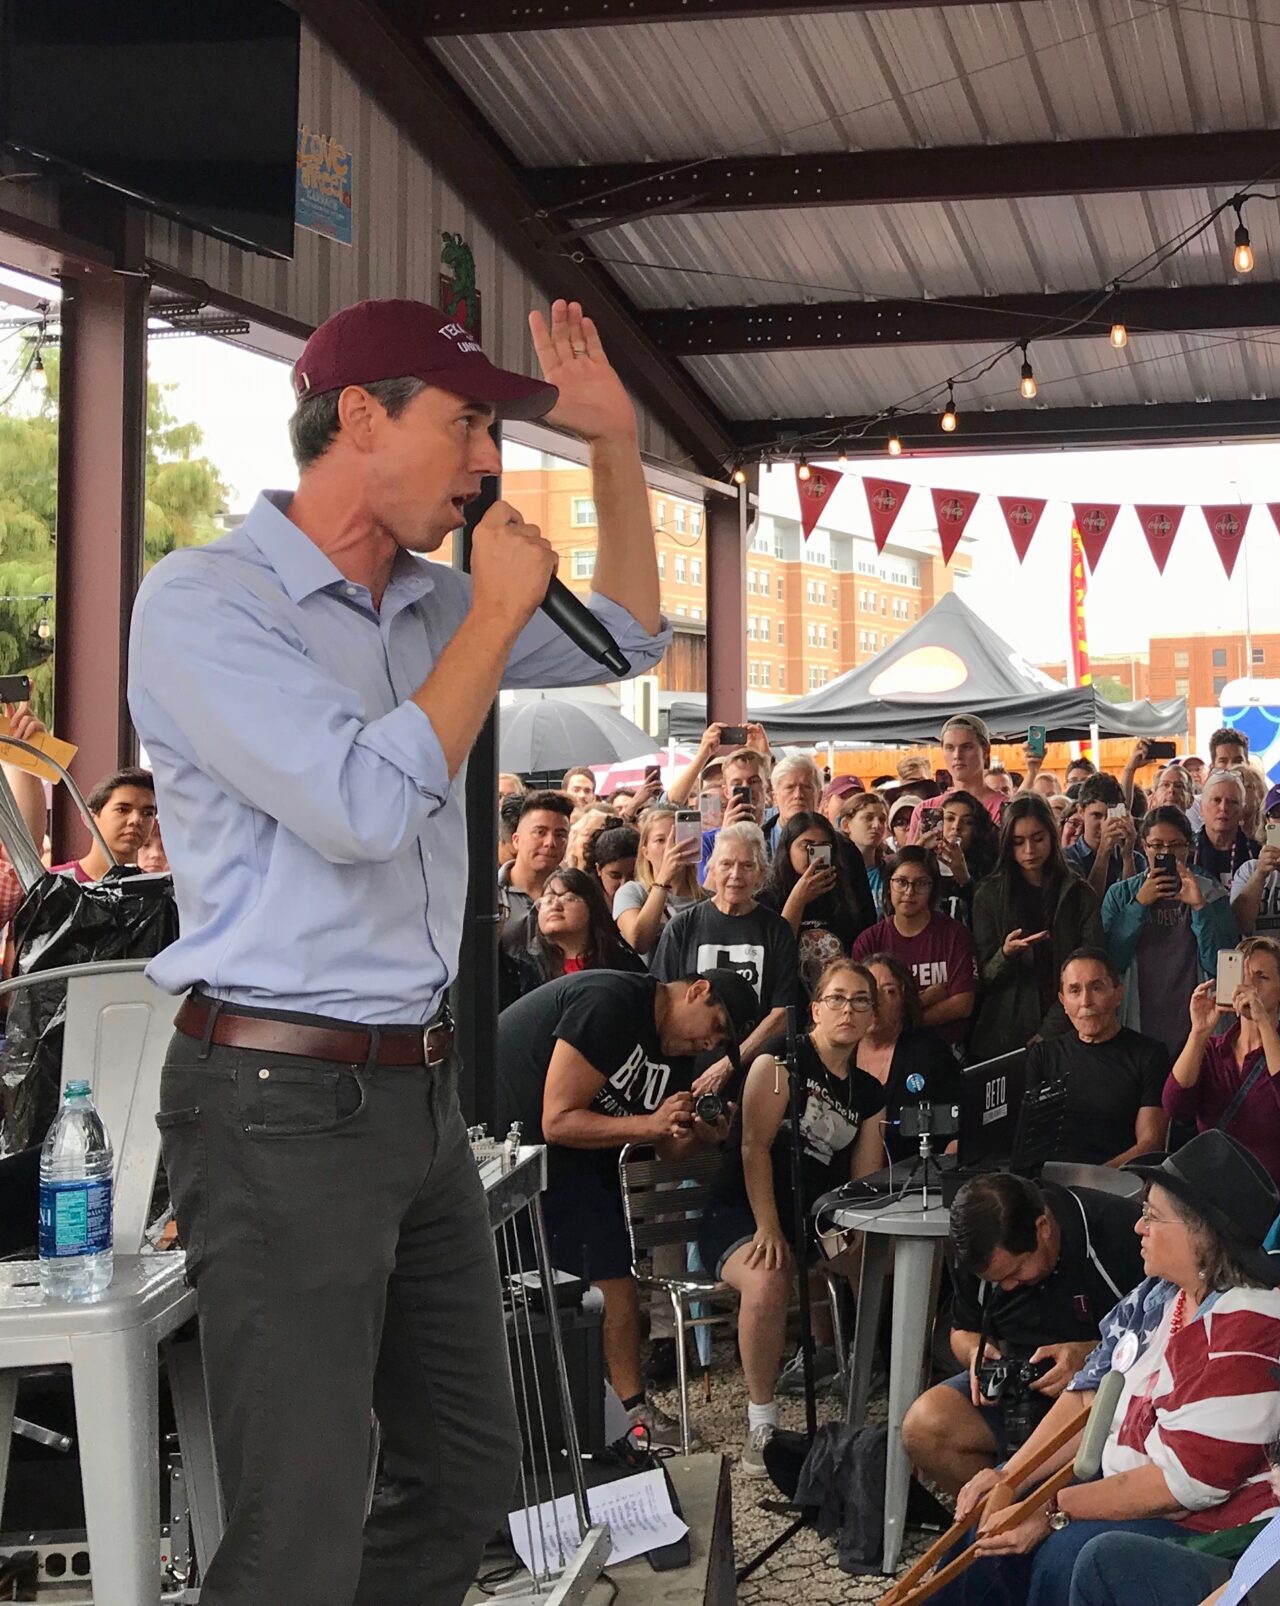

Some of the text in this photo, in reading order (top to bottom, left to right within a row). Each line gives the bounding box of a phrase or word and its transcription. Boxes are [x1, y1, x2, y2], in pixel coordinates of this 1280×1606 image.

[806, 1078, 821, 1092] We
[835, 1100, 848, 1117] Do
[985, 1075, 1006, 1110] BETO
